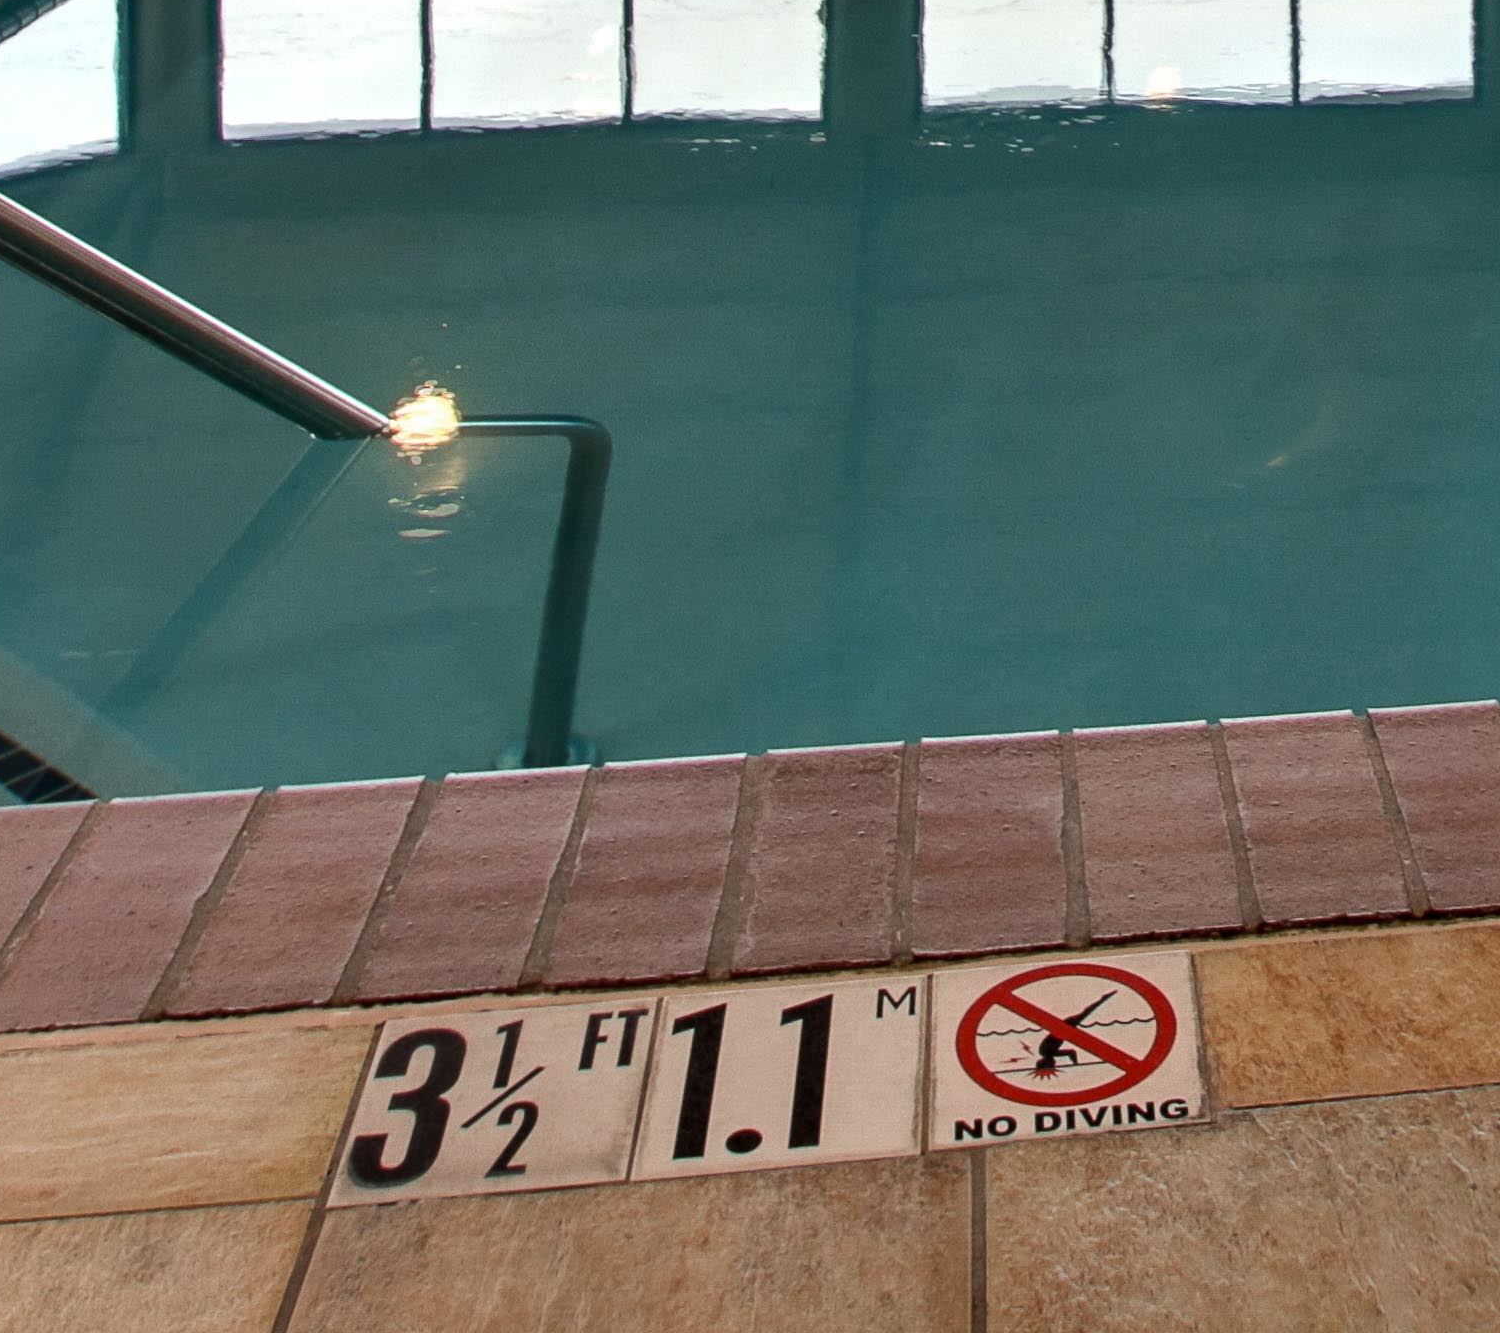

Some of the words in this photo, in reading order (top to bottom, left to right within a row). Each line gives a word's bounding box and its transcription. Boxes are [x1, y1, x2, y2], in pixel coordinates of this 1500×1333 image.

[577, 1008, 649, 1071] FT
[671, 993, 835, 1161] 1.1
[875, 986, 917, 1019] M
[953, 1115, 1018, 1141] NO
[1033, 1097, 1190, 1133] DIVING
